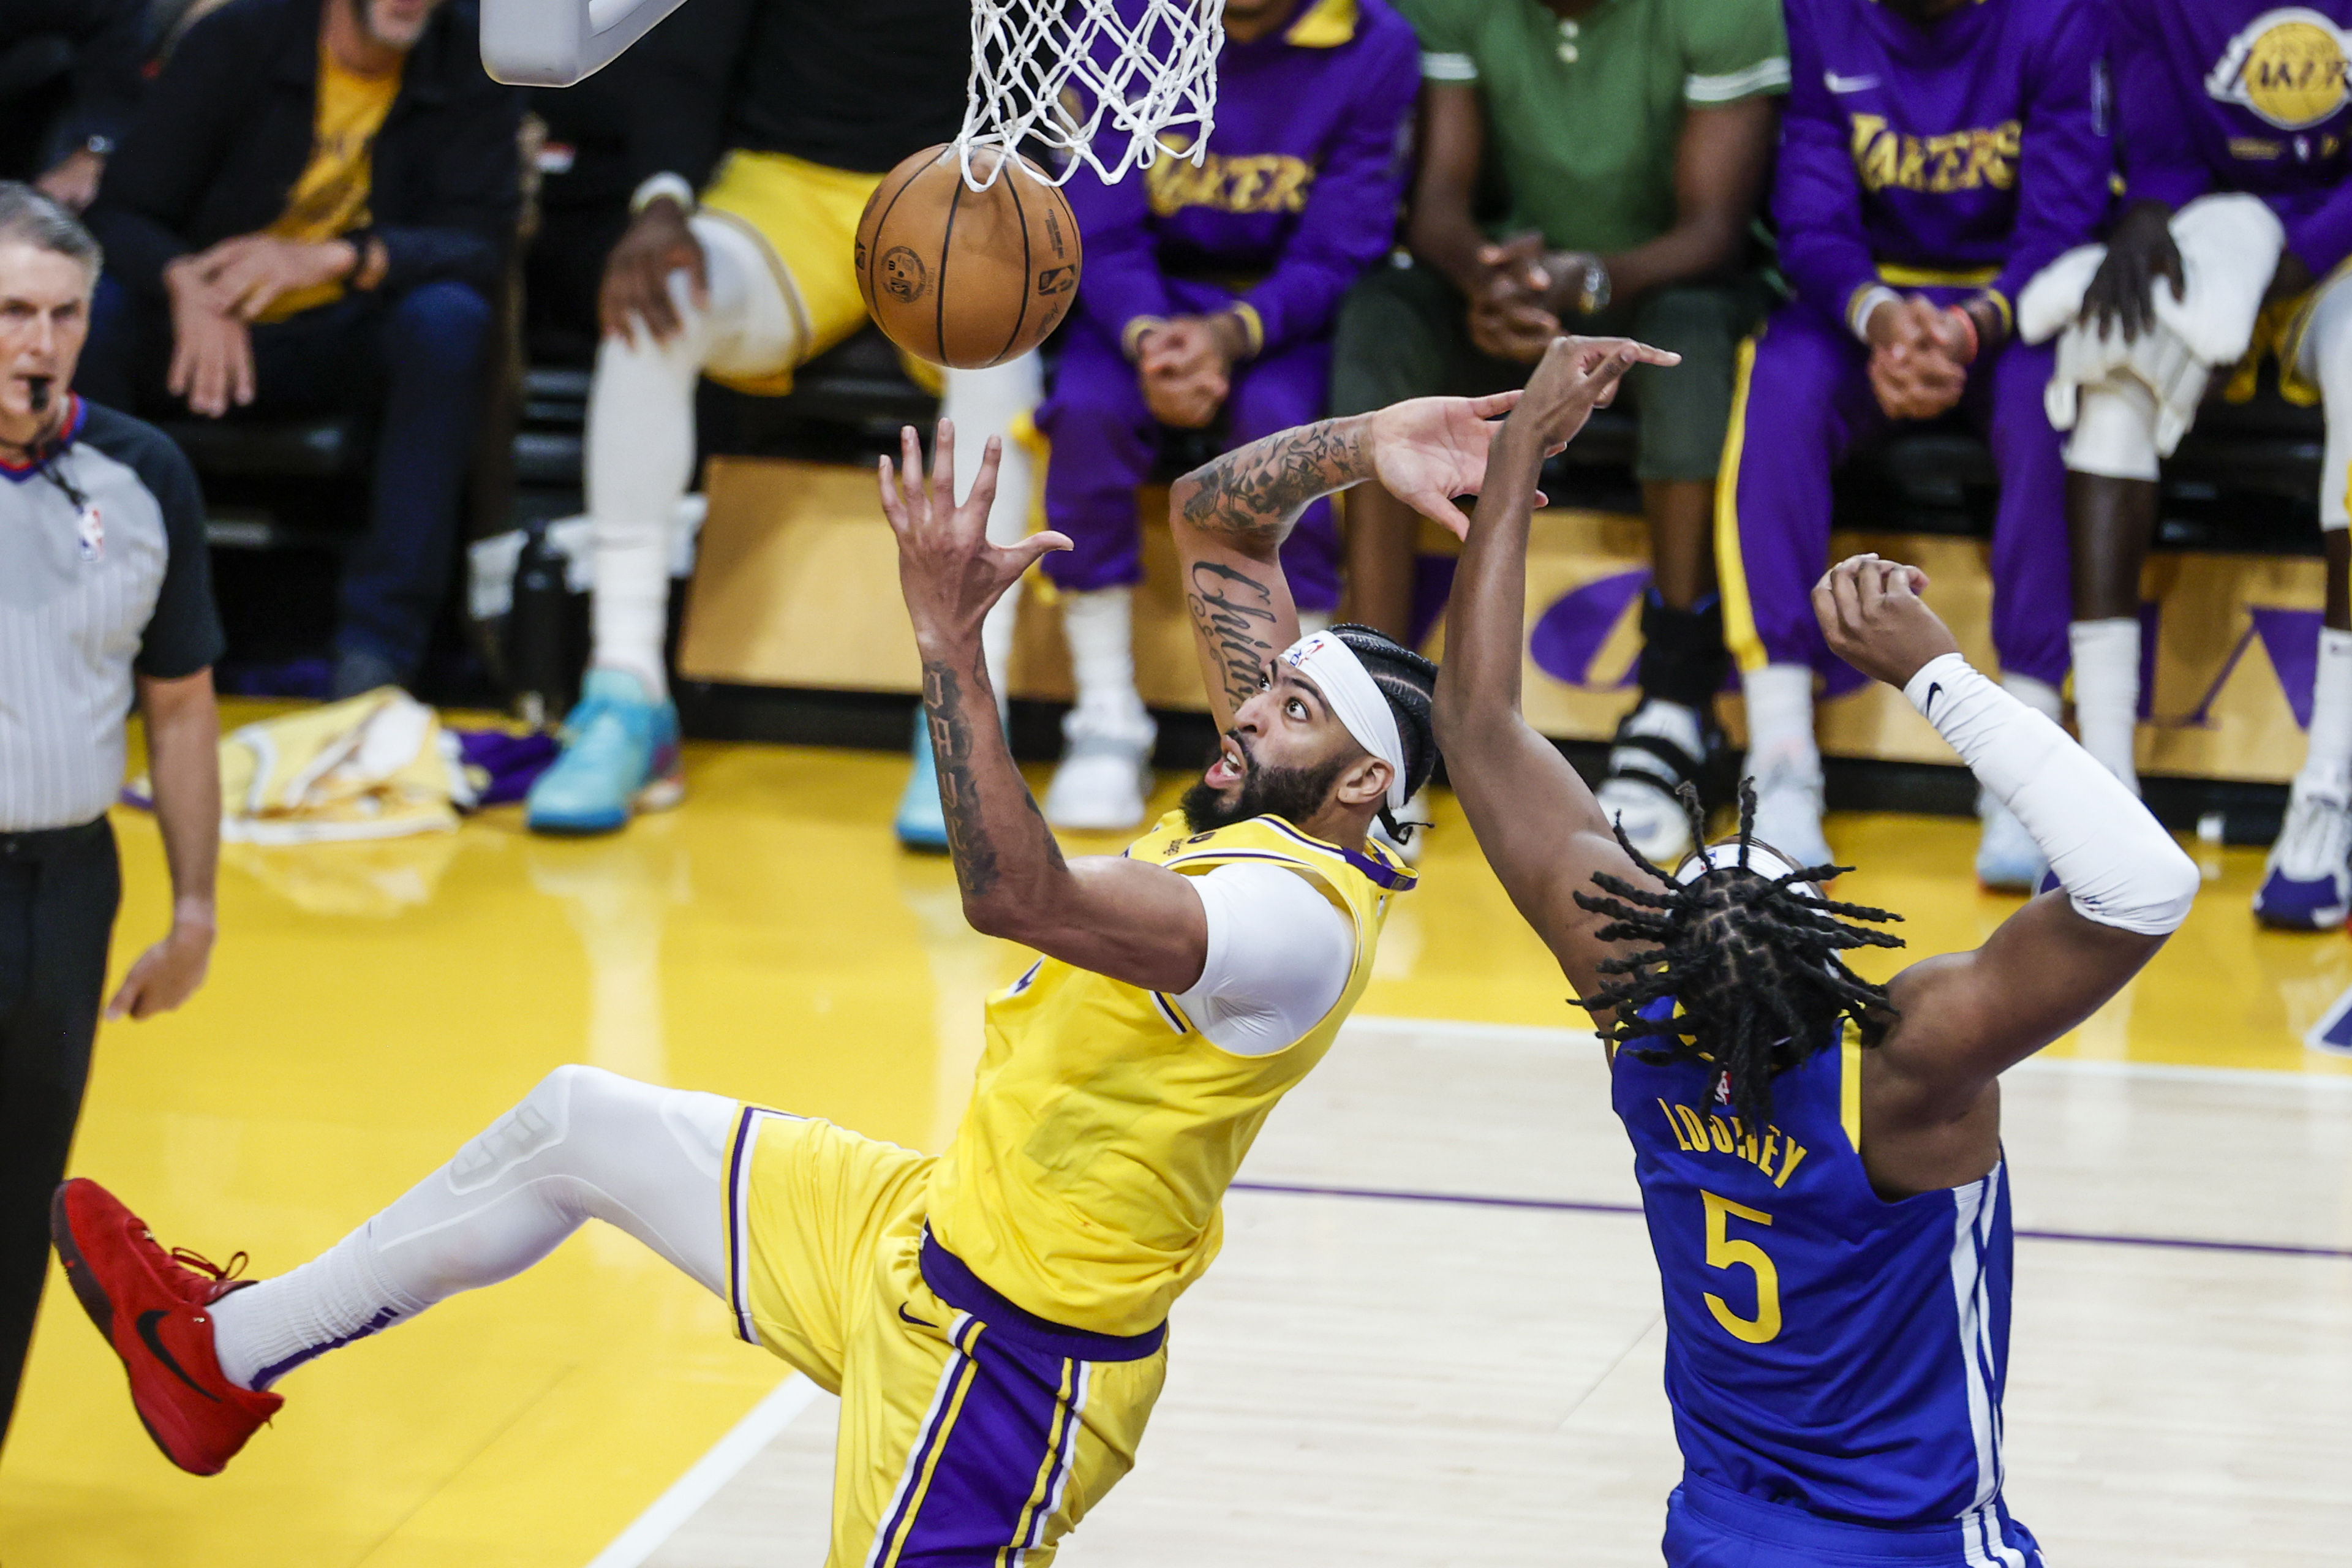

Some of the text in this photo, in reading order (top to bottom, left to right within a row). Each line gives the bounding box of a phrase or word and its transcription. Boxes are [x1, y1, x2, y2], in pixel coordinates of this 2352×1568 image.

[1147, 132, 1317, 217] LAKER
[1850, 113, 2022, 192] LAKERS
[1191, 560, 1277, 695] Chica
[1656, 1097, 1807, 1189] LOONEY
[1700, 1189, 1782, 1344] 5
